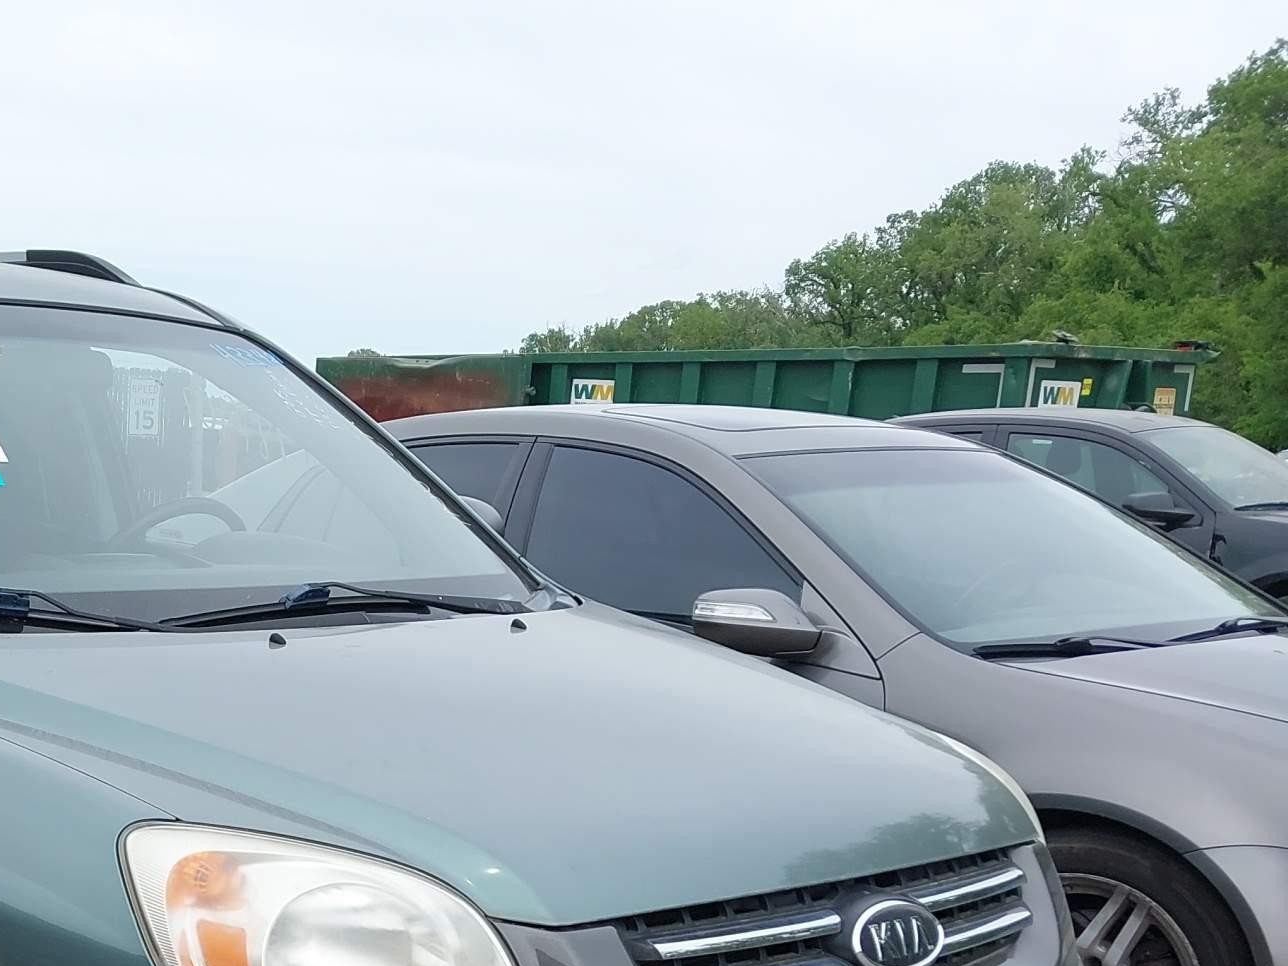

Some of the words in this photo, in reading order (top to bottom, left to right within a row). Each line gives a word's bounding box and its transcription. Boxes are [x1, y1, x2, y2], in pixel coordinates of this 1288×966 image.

[574, 384, 614, 400] WM
[1043, 387, 1074, 404] WM
[135, 411, 154, 429] 15
[867, 915, 934, 961] KIA
